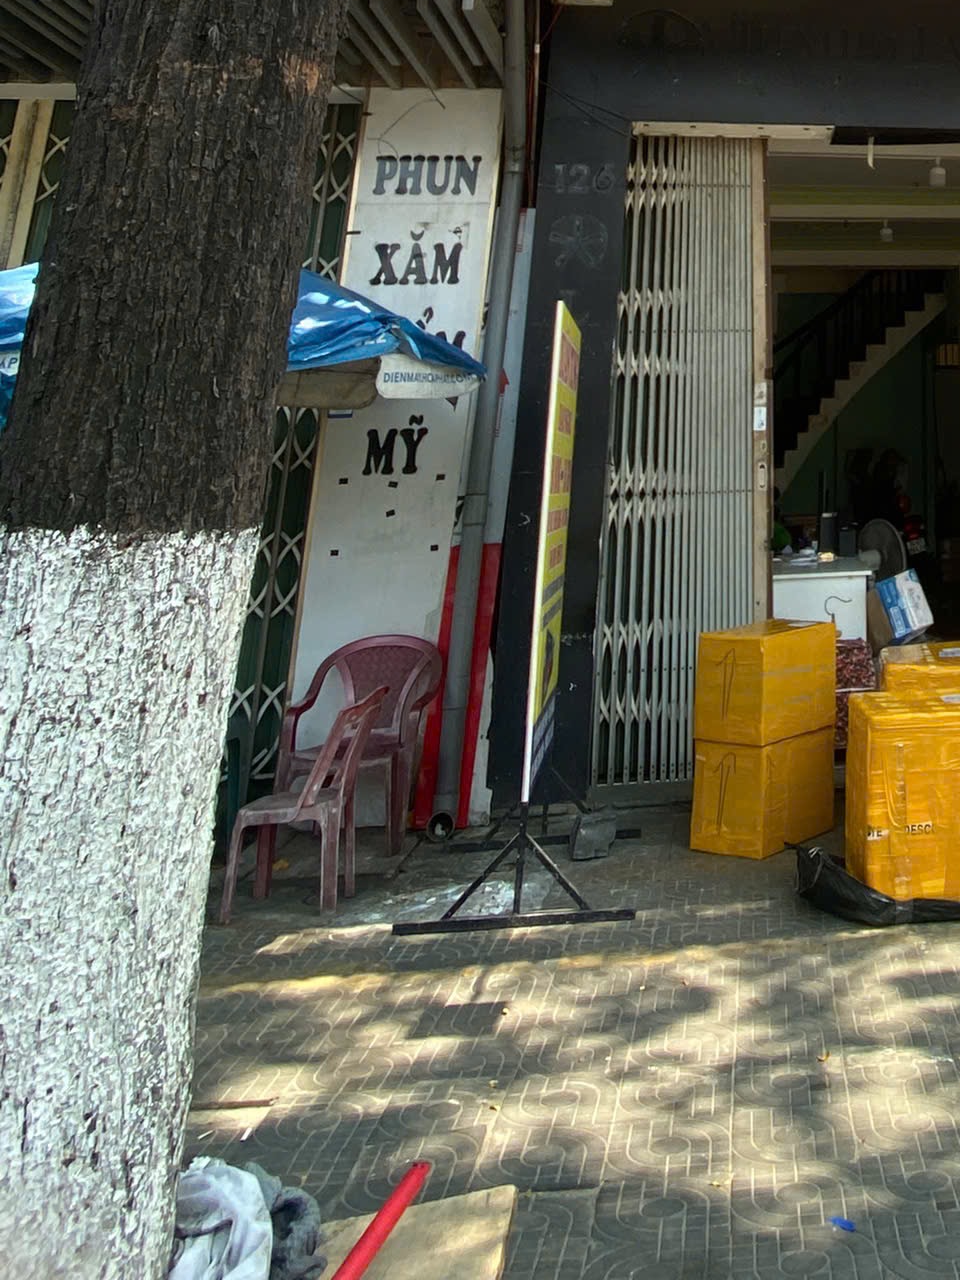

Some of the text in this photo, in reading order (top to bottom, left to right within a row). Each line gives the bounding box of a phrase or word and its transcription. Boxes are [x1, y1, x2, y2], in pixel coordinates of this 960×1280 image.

[372, 154, 482, 196] PHUN
[369, 229, 464, 286] XĂM
[362, 414, 428, 476] MỸ
